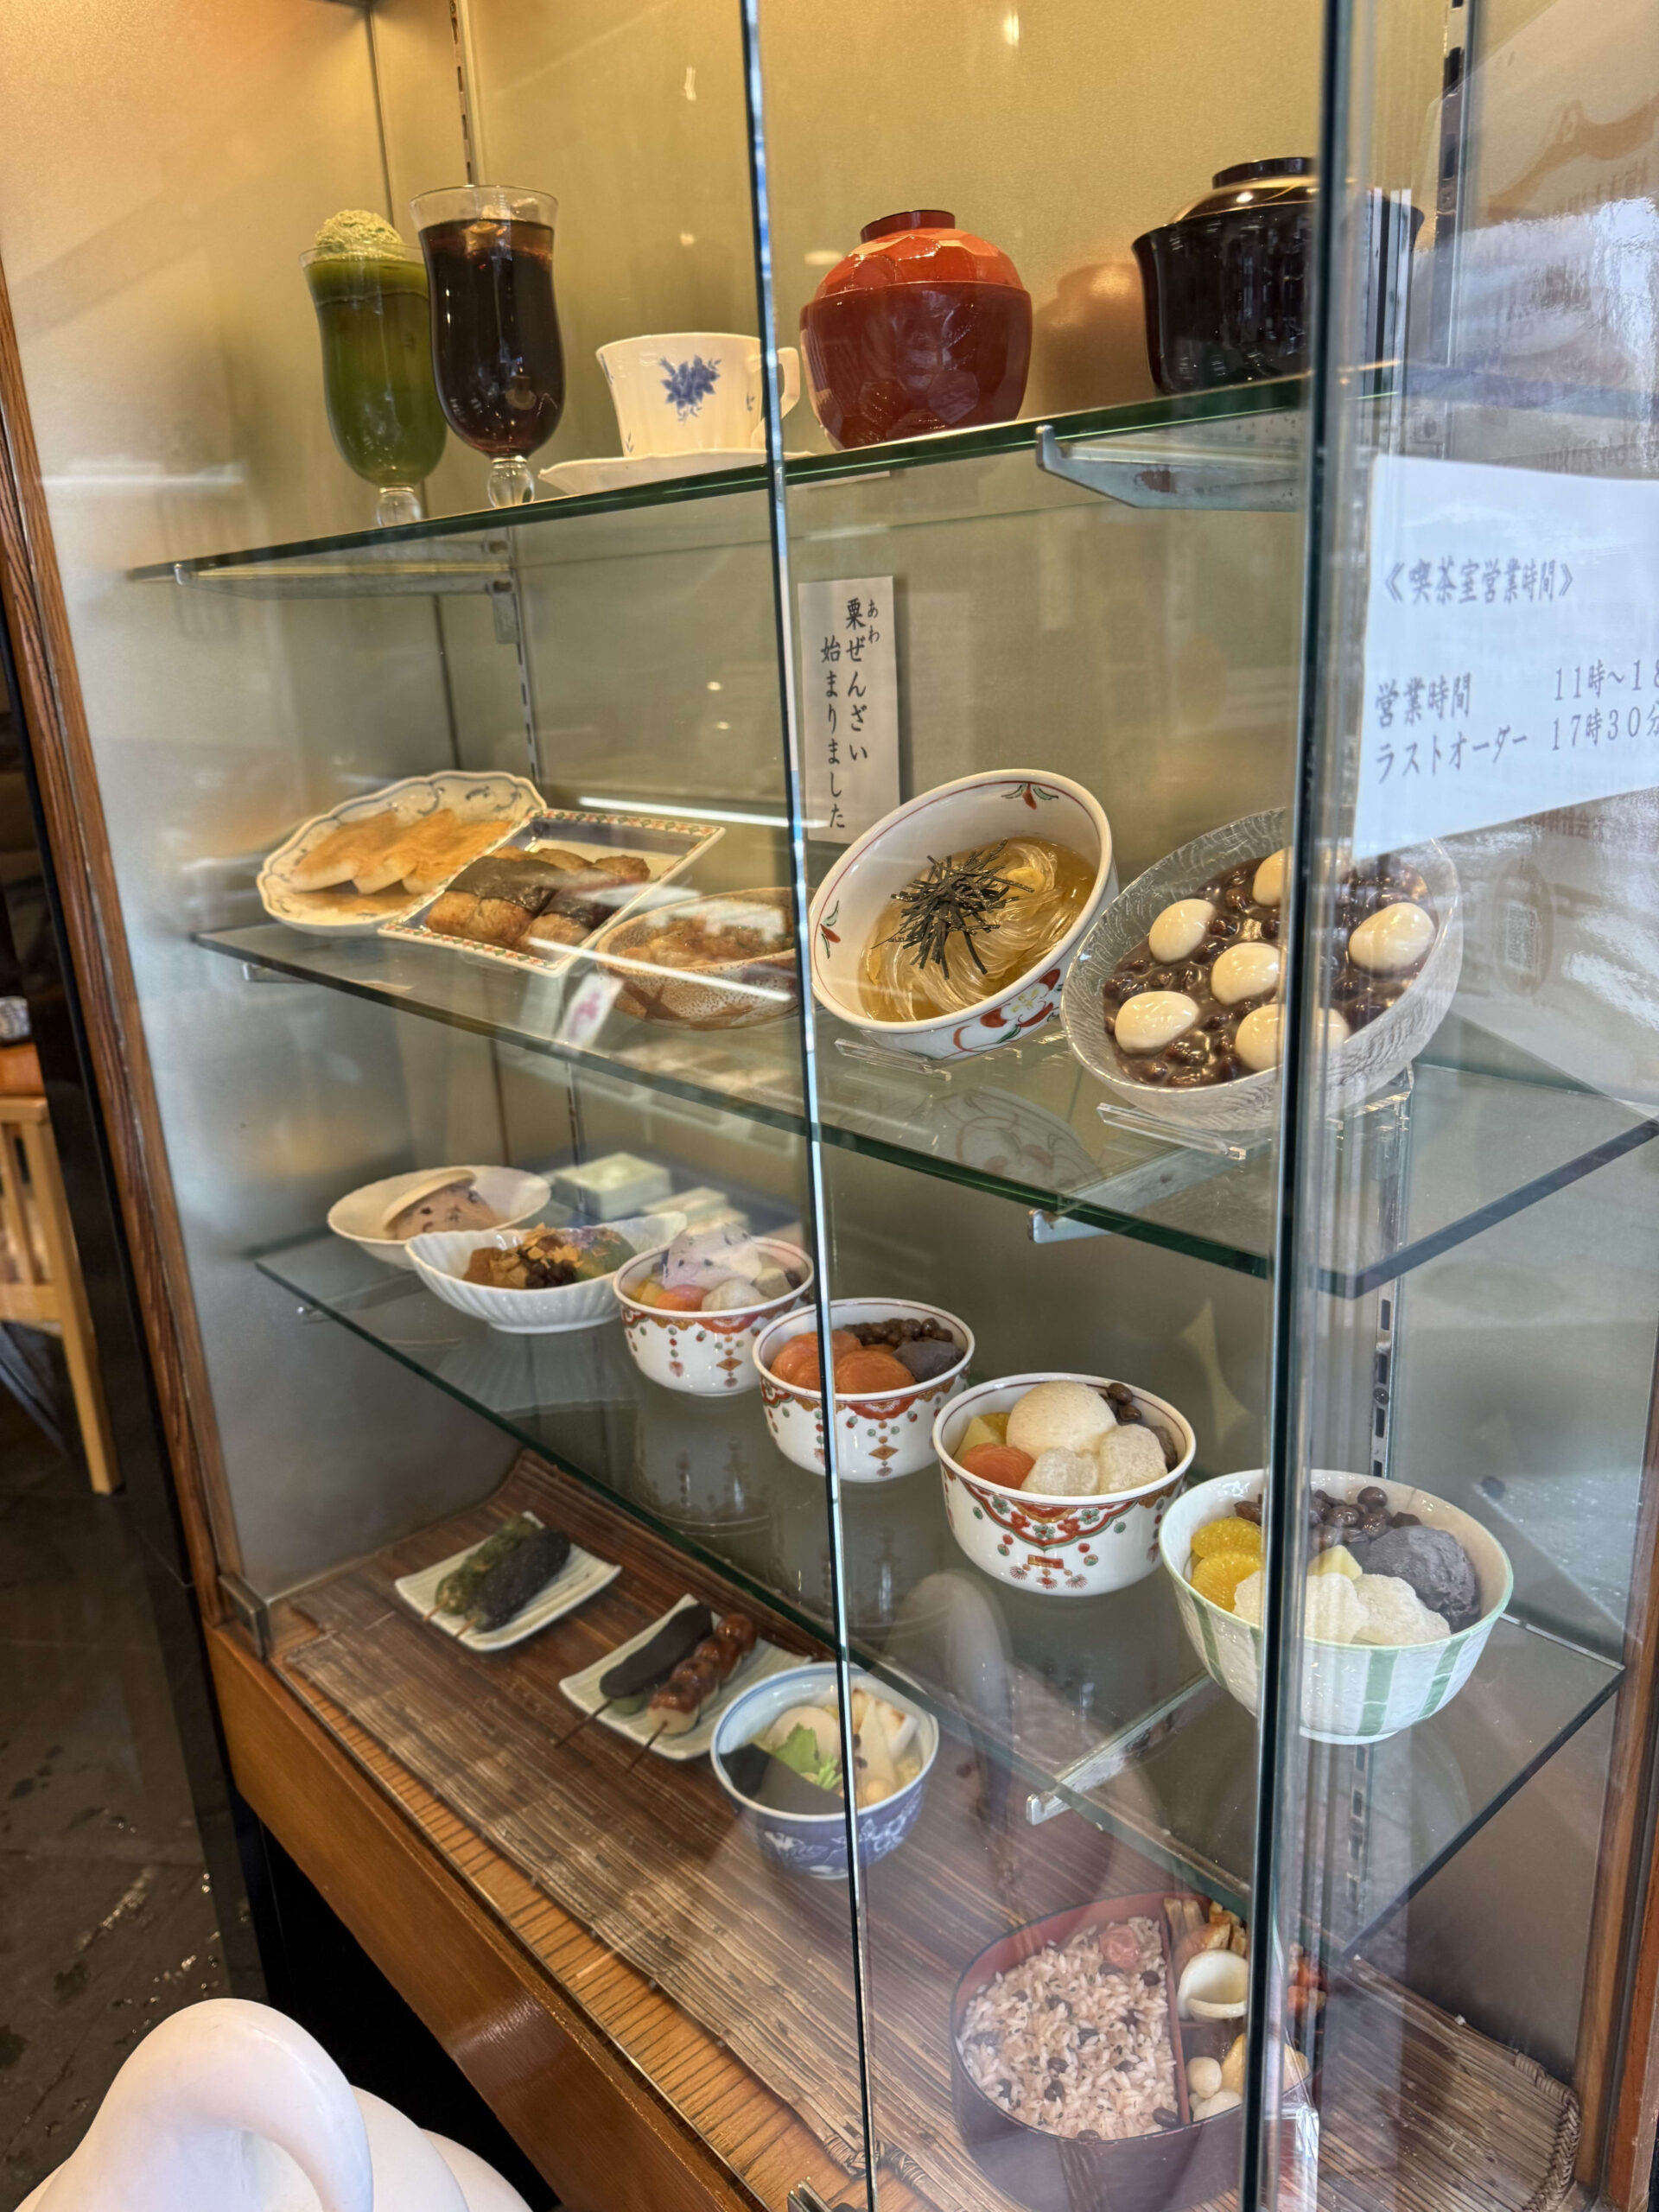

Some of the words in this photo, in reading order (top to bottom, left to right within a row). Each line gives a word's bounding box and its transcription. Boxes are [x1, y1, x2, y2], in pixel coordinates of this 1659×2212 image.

[868, 599, 880, 645] あわ
[845, 597, 868, 760] 粟ぜんざい
[1376, 672, 1471, 728] 営業時間
[821, 635, 846, 829] 始まりました
[1376, 724, 1528, 784] ラストオーダー
